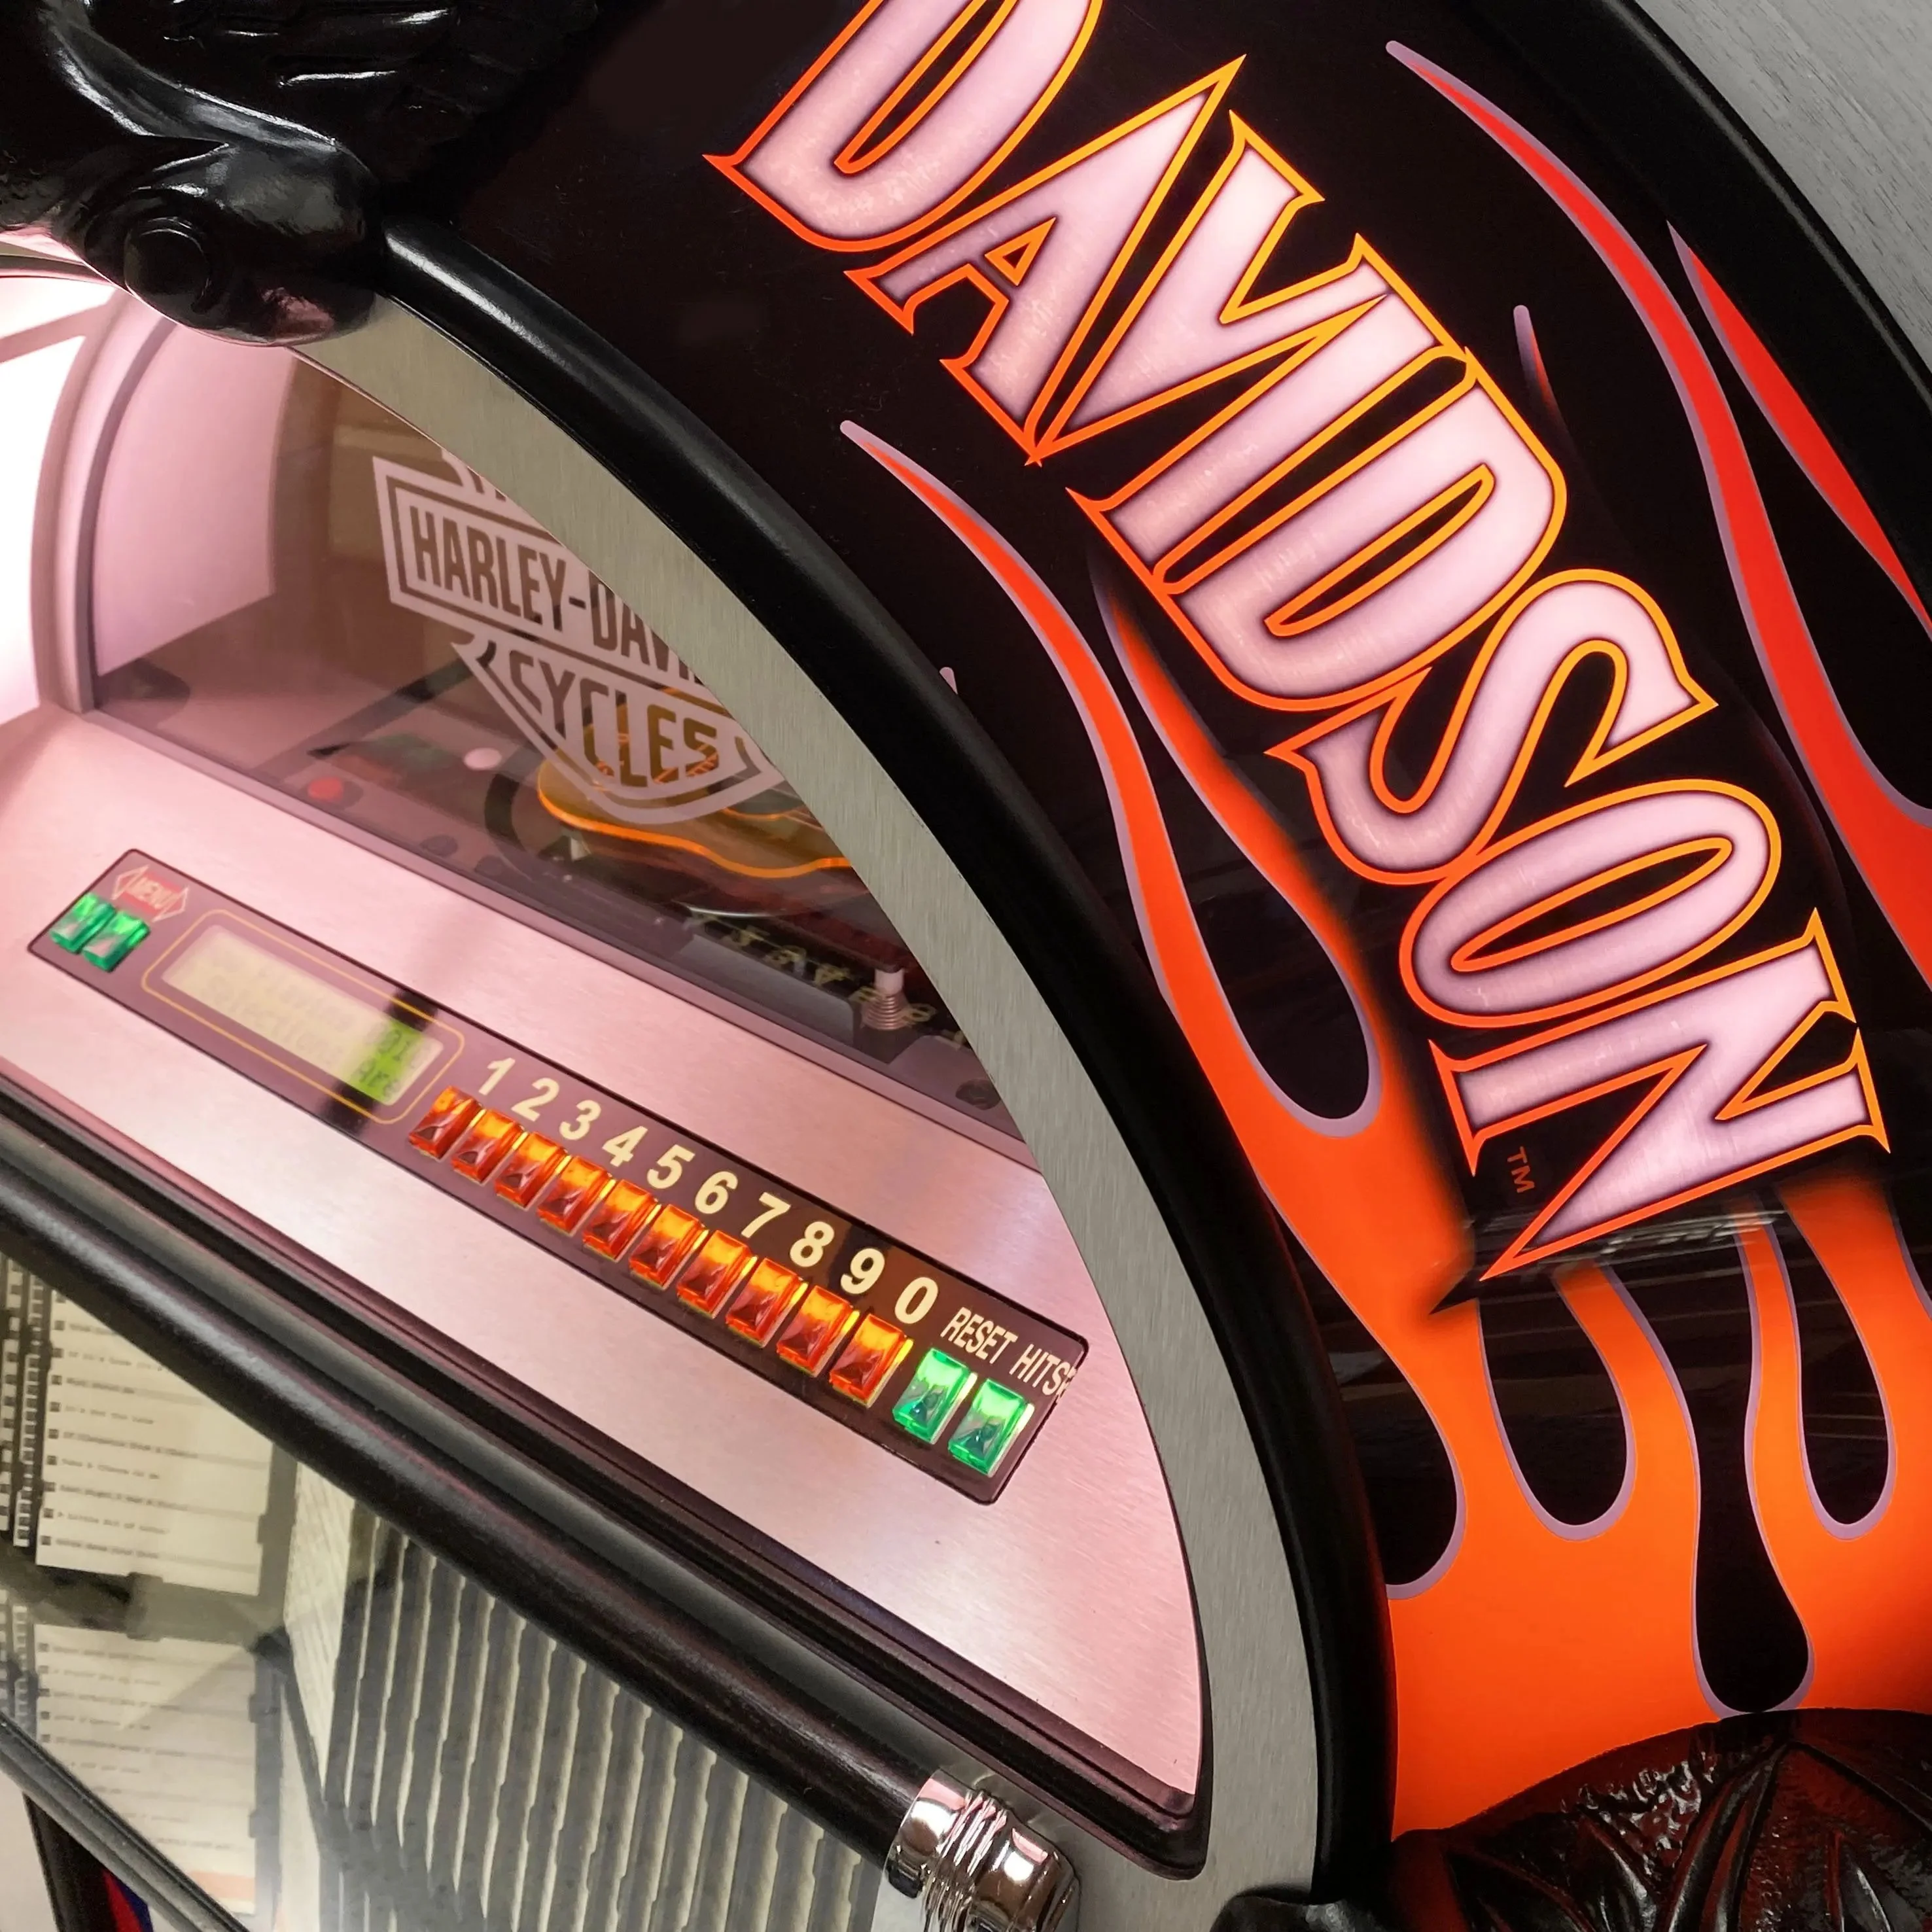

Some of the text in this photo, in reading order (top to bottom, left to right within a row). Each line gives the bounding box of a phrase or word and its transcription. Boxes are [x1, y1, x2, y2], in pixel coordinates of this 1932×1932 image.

[410, 506, 705, 686] HARLEY-DAV
[702, 0, 1889, 1280] DAVIDSON
[509, 648, 720, 786] CYCLES
[478, 1057, 516, 1095] 1
[512, 1078, 559, 1121] 2
[559, 1100, 601, 1140] 3
[602, 1125, 648, 1167] 4
[646, 1144, 695, 1189] 5
[694, 1171, 739, 1214] 6
[741, 1191, 791, 1238] 7
[790, 1221, 835, 1267] 8
[840, 1248, 885, 1295] 9
[894, 1276, 939, 1324] 0
[940, 1307, 1019, 1365] RESET
[1507, 1146, 1535, 1194] TM
